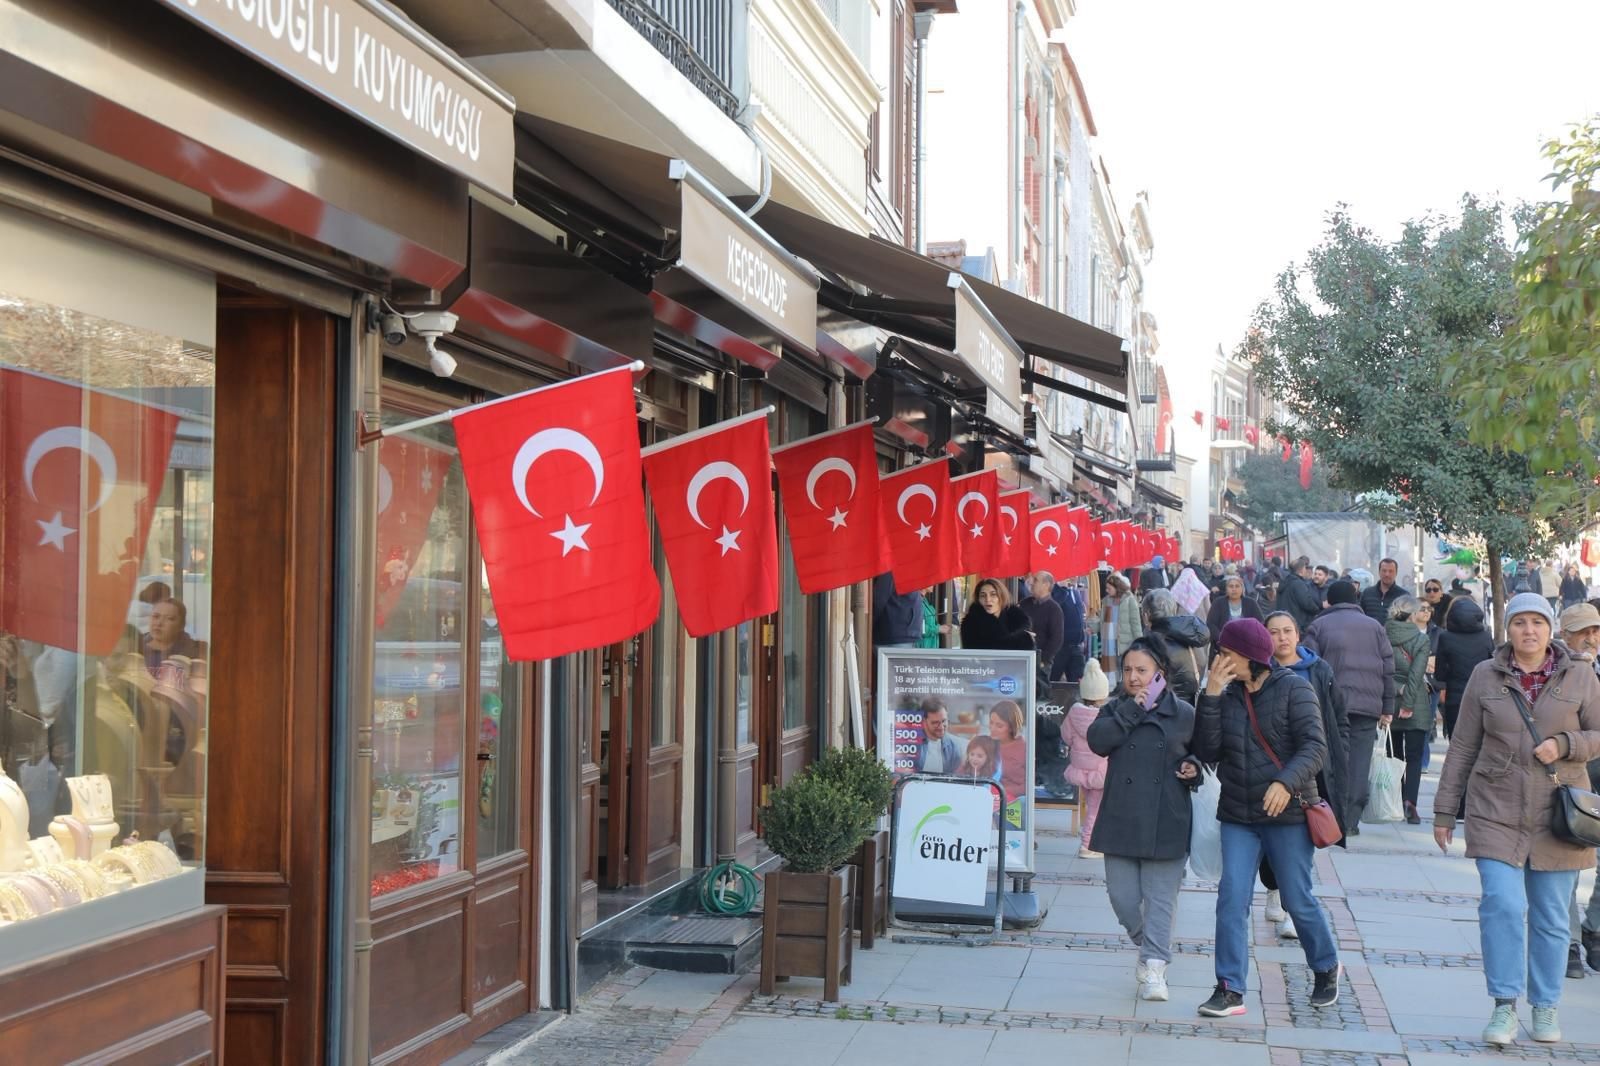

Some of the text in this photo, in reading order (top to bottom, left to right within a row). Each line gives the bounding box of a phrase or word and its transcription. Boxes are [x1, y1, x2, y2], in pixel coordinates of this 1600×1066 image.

[354, 26, 482, 161] KUYUMCUSU
[727, 235, 787, 318] KEÇECİZADE
[894, 665, 995, 677] Türk Telekom kalitesiyle
[894, 676, 904, 684] 18
[917, 676, 939, 684] sabit
[940, 676, 960, 686] fiyat
[894, 687, 965, 695] garantili internet
[895, 713, 922, 723] 1000
[895, 729, 918, 739] 500
[895, 744, 917, 754] 200
[895, 759, 914, 768] 100
[921, 834, 944, 842] foto
[920, 837, 988, 864] ender
